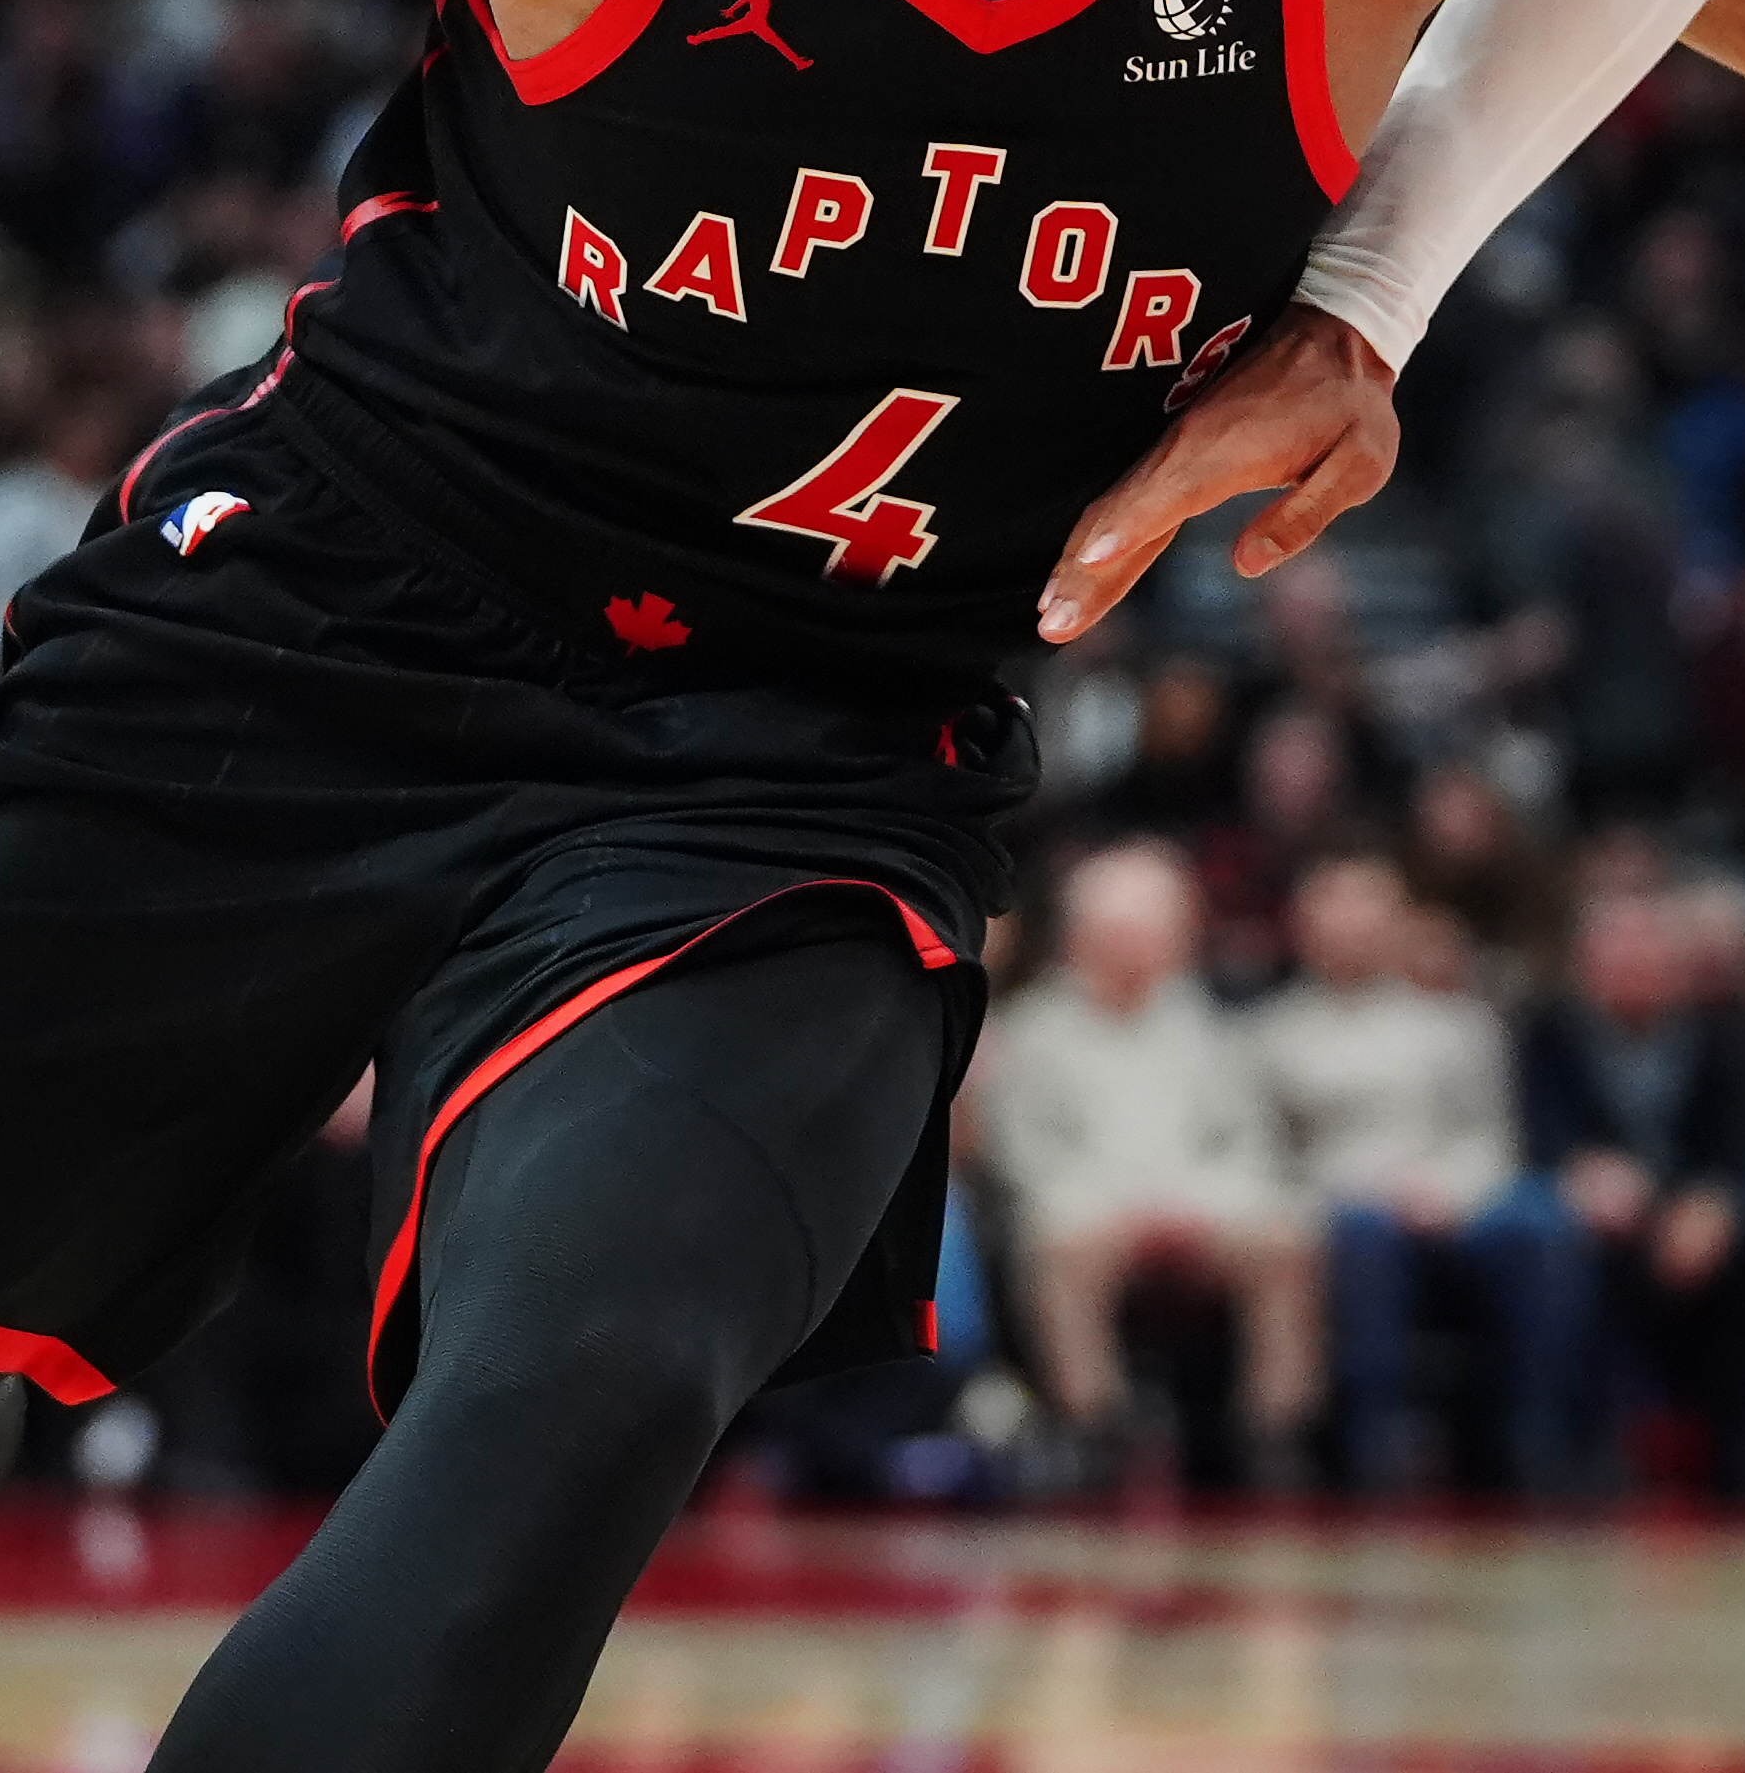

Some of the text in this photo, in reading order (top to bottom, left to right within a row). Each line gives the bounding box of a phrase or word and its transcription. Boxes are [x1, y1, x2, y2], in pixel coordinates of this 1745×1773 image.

[1123, 40, 1257, 83] Sun Life
[557, 142, 1252, 414] RAPTORS
[732, 387, 962, 589] 4
